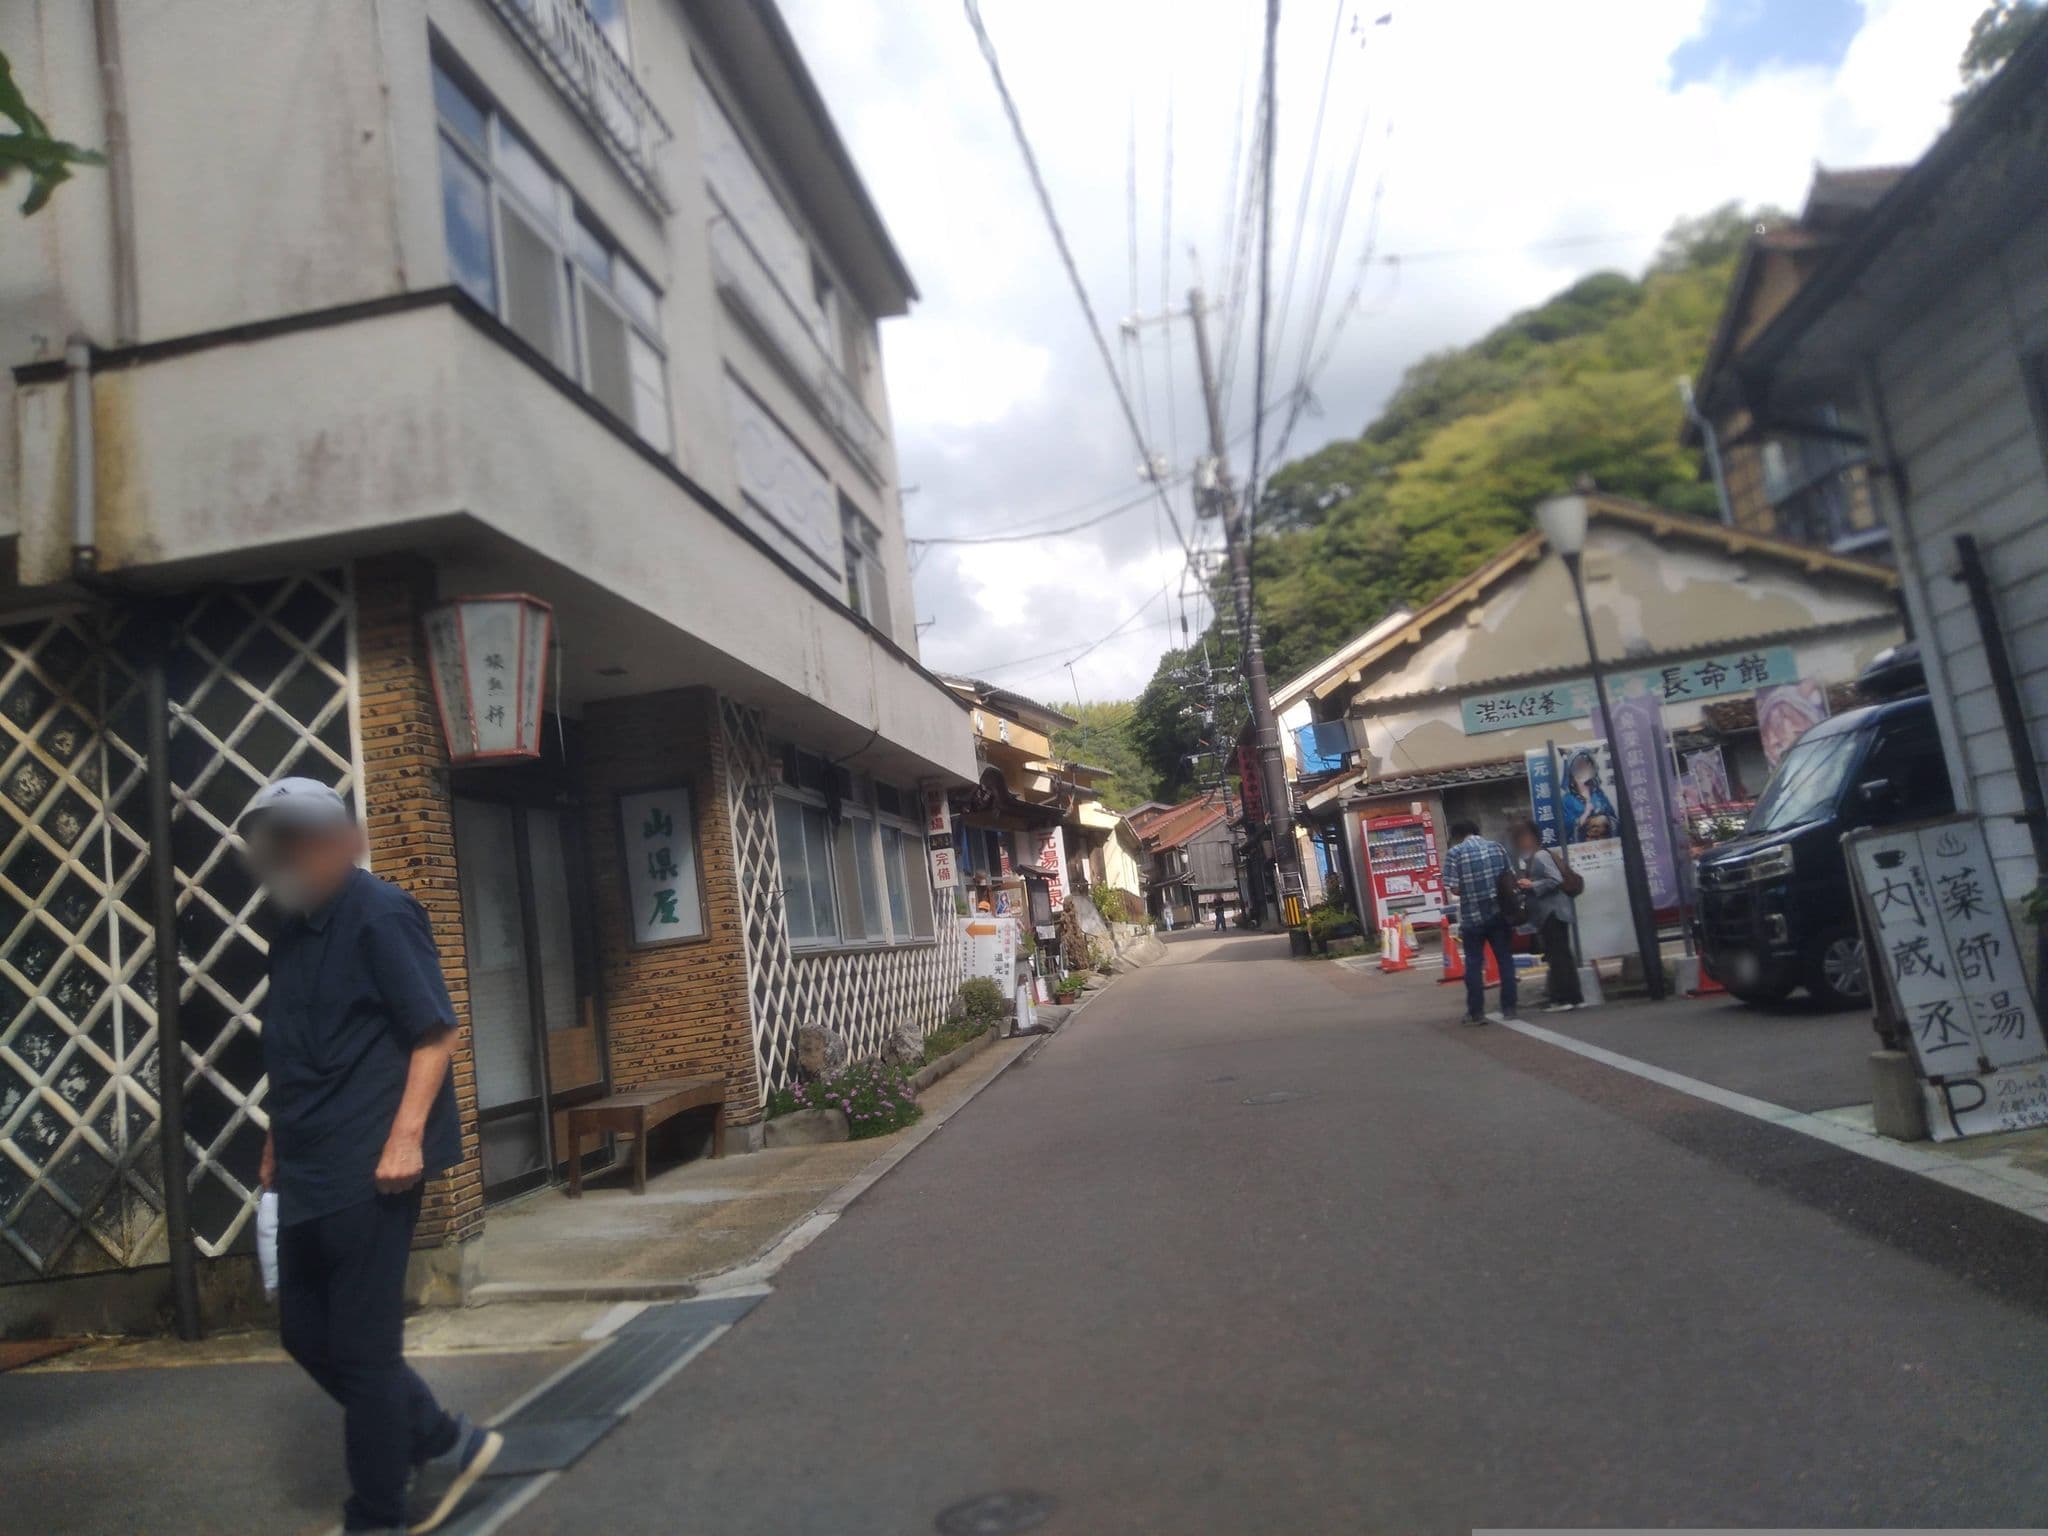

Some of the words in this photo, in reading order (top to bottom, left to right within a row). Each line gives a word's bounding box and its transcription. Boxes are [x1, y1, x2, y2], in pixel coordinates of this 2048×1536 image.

[1661, 655, 1770, 699] 長命館
[1534, 760, 1557, 844] 元湯温泉
[643, 807, 680, 928] 山県屋
[935, 851, 951, 881] 完備
[1871, 876, 1973, 1055] 内蔵丞
[1936, 867, 2026, 1041] 薬師湯
[1942, 1077, 1987, 1138] P
